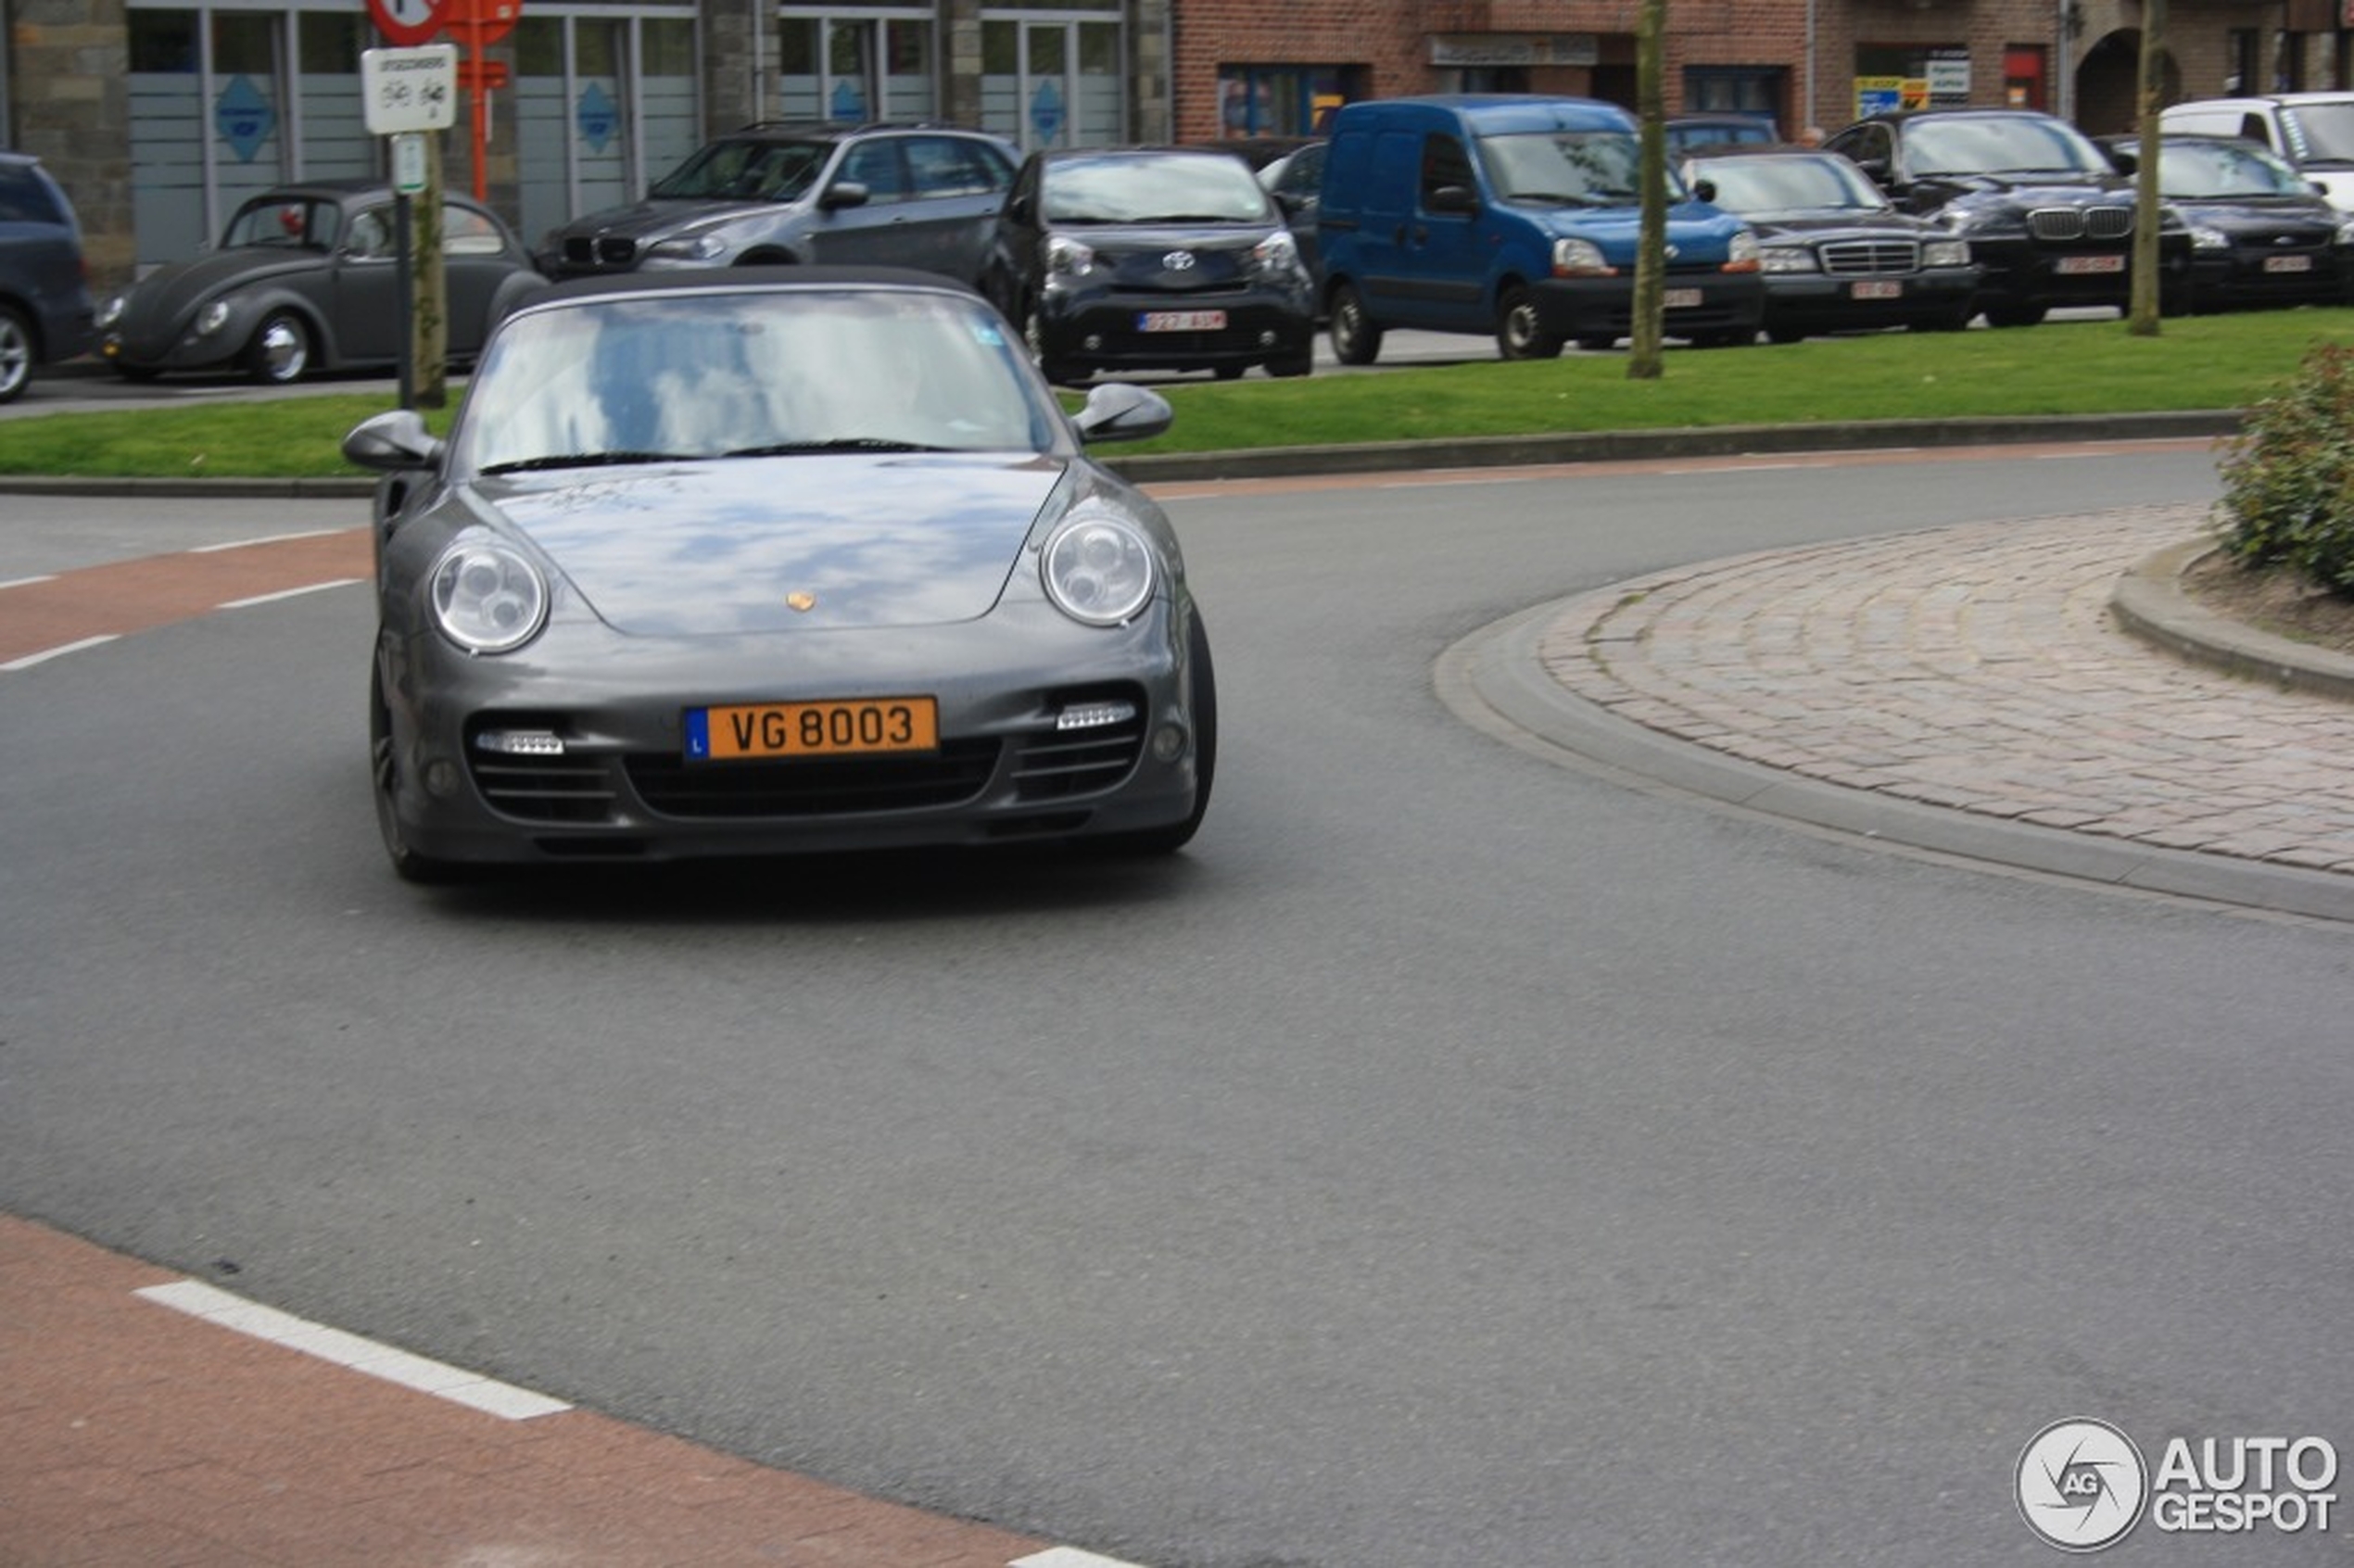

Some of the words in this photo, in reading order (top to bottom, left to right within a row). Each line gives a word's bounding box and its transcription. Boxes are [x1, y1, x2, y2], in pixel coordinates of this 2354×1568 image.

[692, 739, 702, 753] L
[731, 711, 787, 752] VG
[799, 706, 913, 748] 8003
